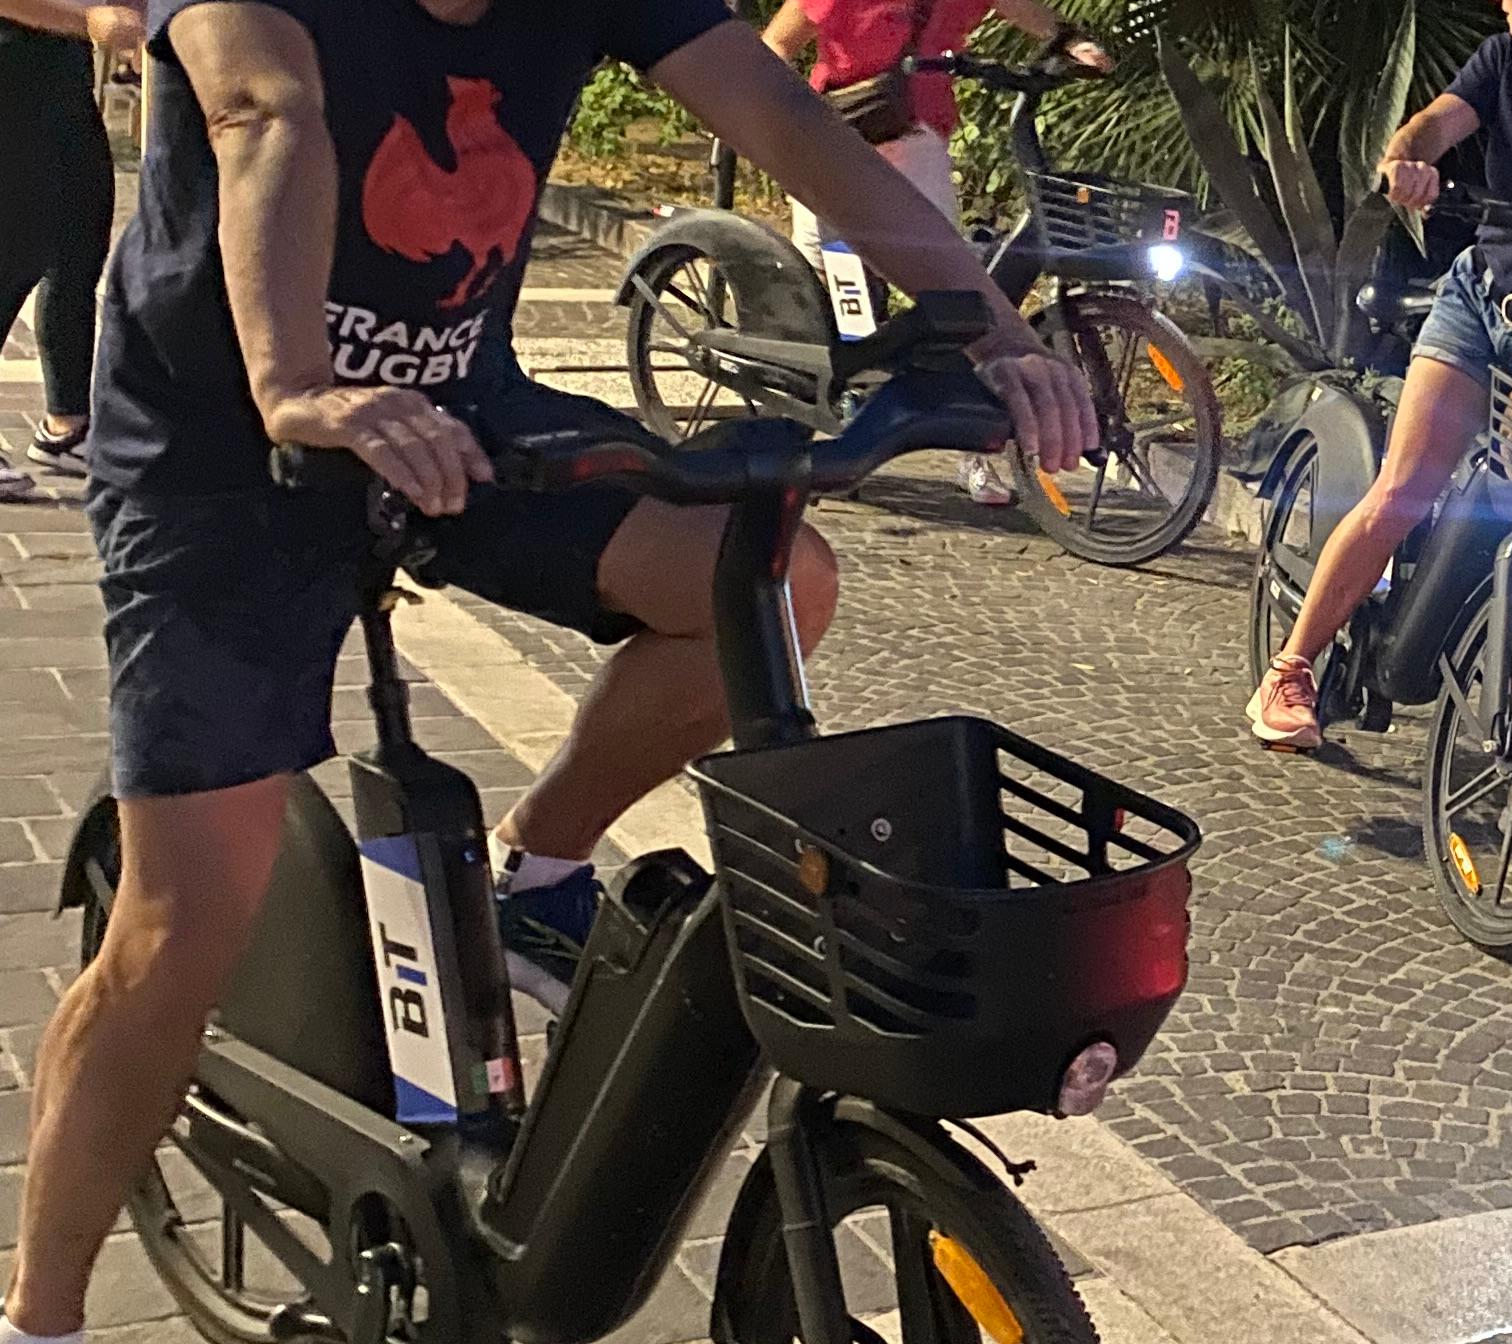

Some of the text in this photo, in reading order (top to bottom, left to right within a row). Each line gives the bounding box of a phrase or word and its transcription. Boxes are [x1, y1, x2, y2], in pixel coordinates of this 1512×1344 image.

[833, 274, 862, 316] BIT
[329, 340, 477, 385] UGBY
[378, 922, 429, 1038] BIT
